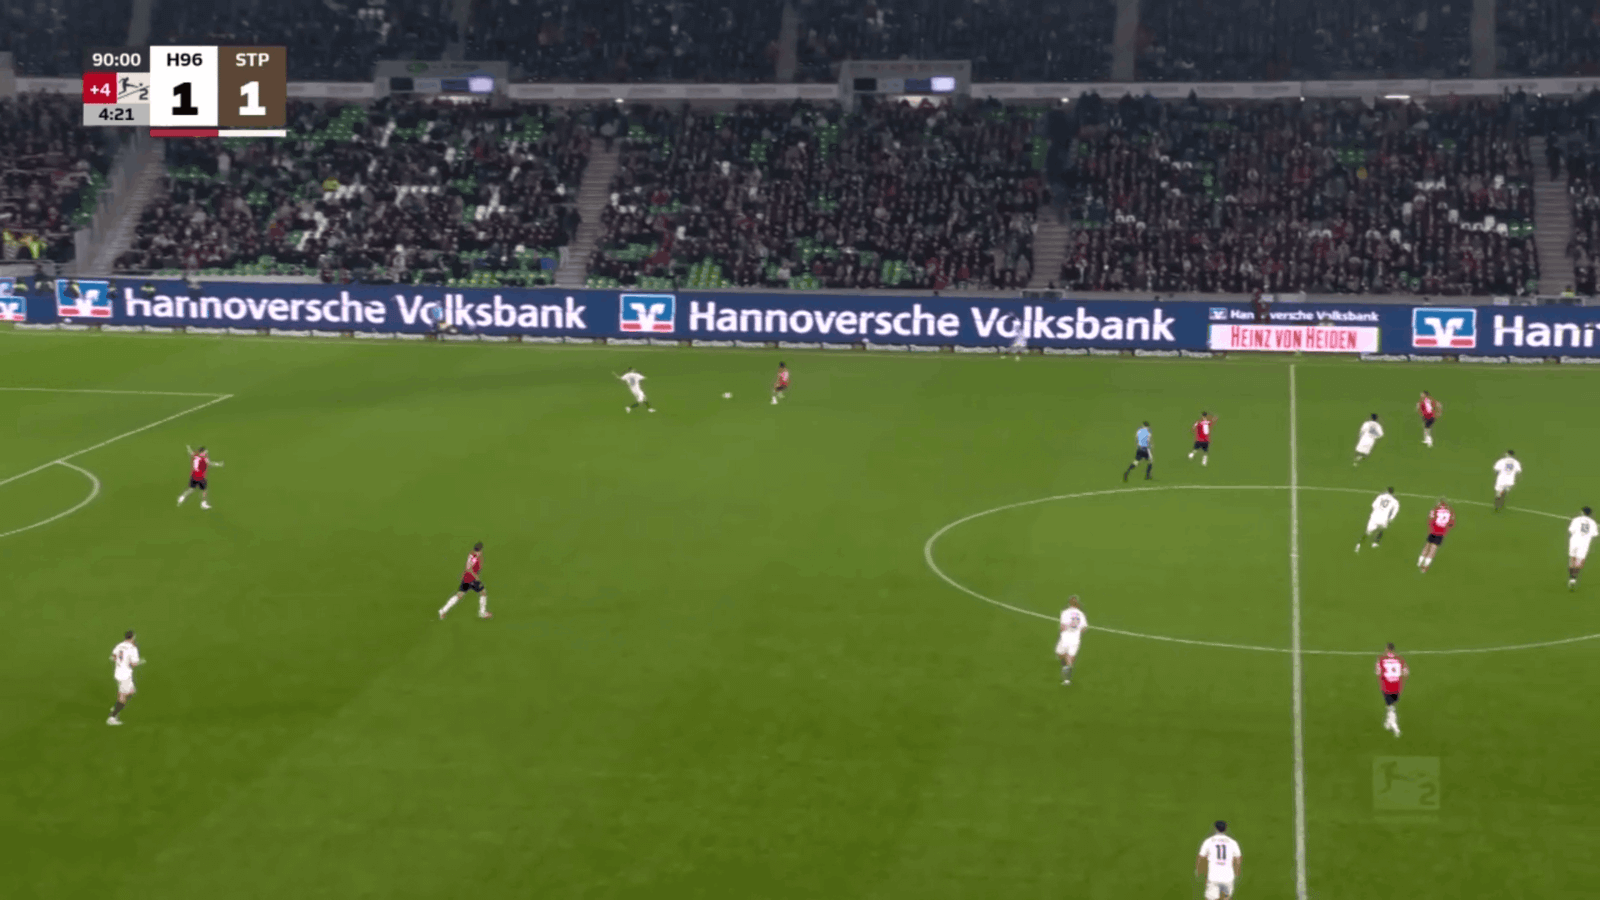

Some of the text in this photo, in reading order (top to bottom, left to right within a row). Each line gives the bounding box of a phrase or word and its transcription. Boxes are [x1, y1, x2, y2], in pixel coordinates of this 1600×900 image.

[689, 300, 1176, 341] Hannoversche Volksbank
[1230, 309, 1314, 321] Hanversche
[1231, 325, 1271, 348] HEINZ
[1306, 326, 1358, 349] HEIDEN
[1215, 844, 1227, 860] 11
